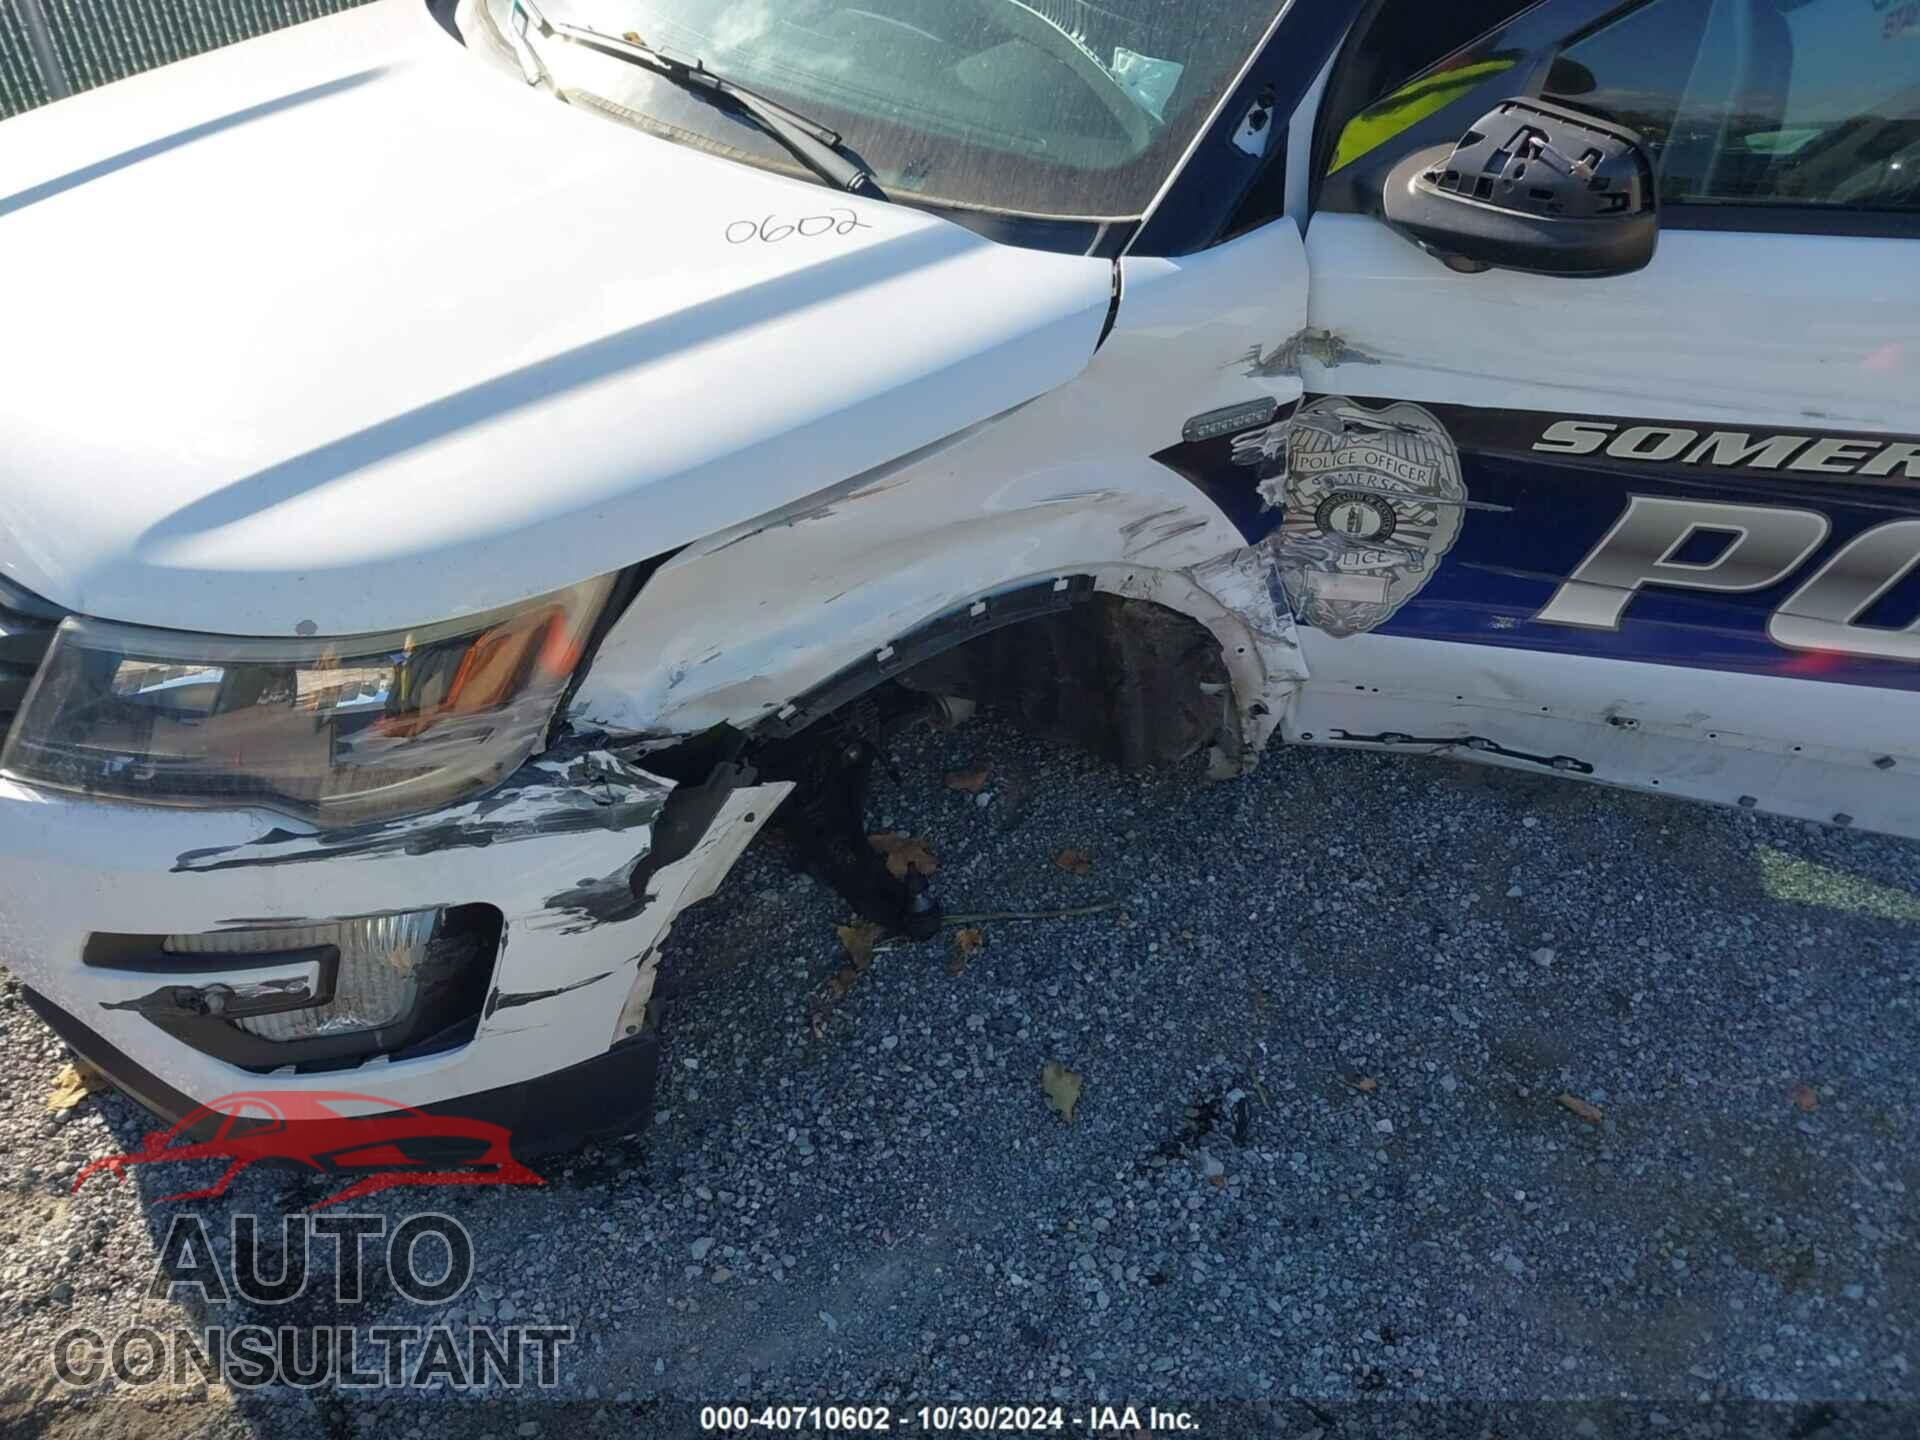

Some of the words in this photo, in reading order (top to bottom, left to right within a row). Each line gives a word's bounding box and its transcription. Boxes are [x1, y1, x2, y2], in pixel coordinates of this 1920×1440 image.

[725, 208, 873, 244] 0602
[1300, 451, 1357, 470] POLICE
[1364, 451, 1427, 483] OFFICER
[1532, 420, 1920, 478] SOMER
